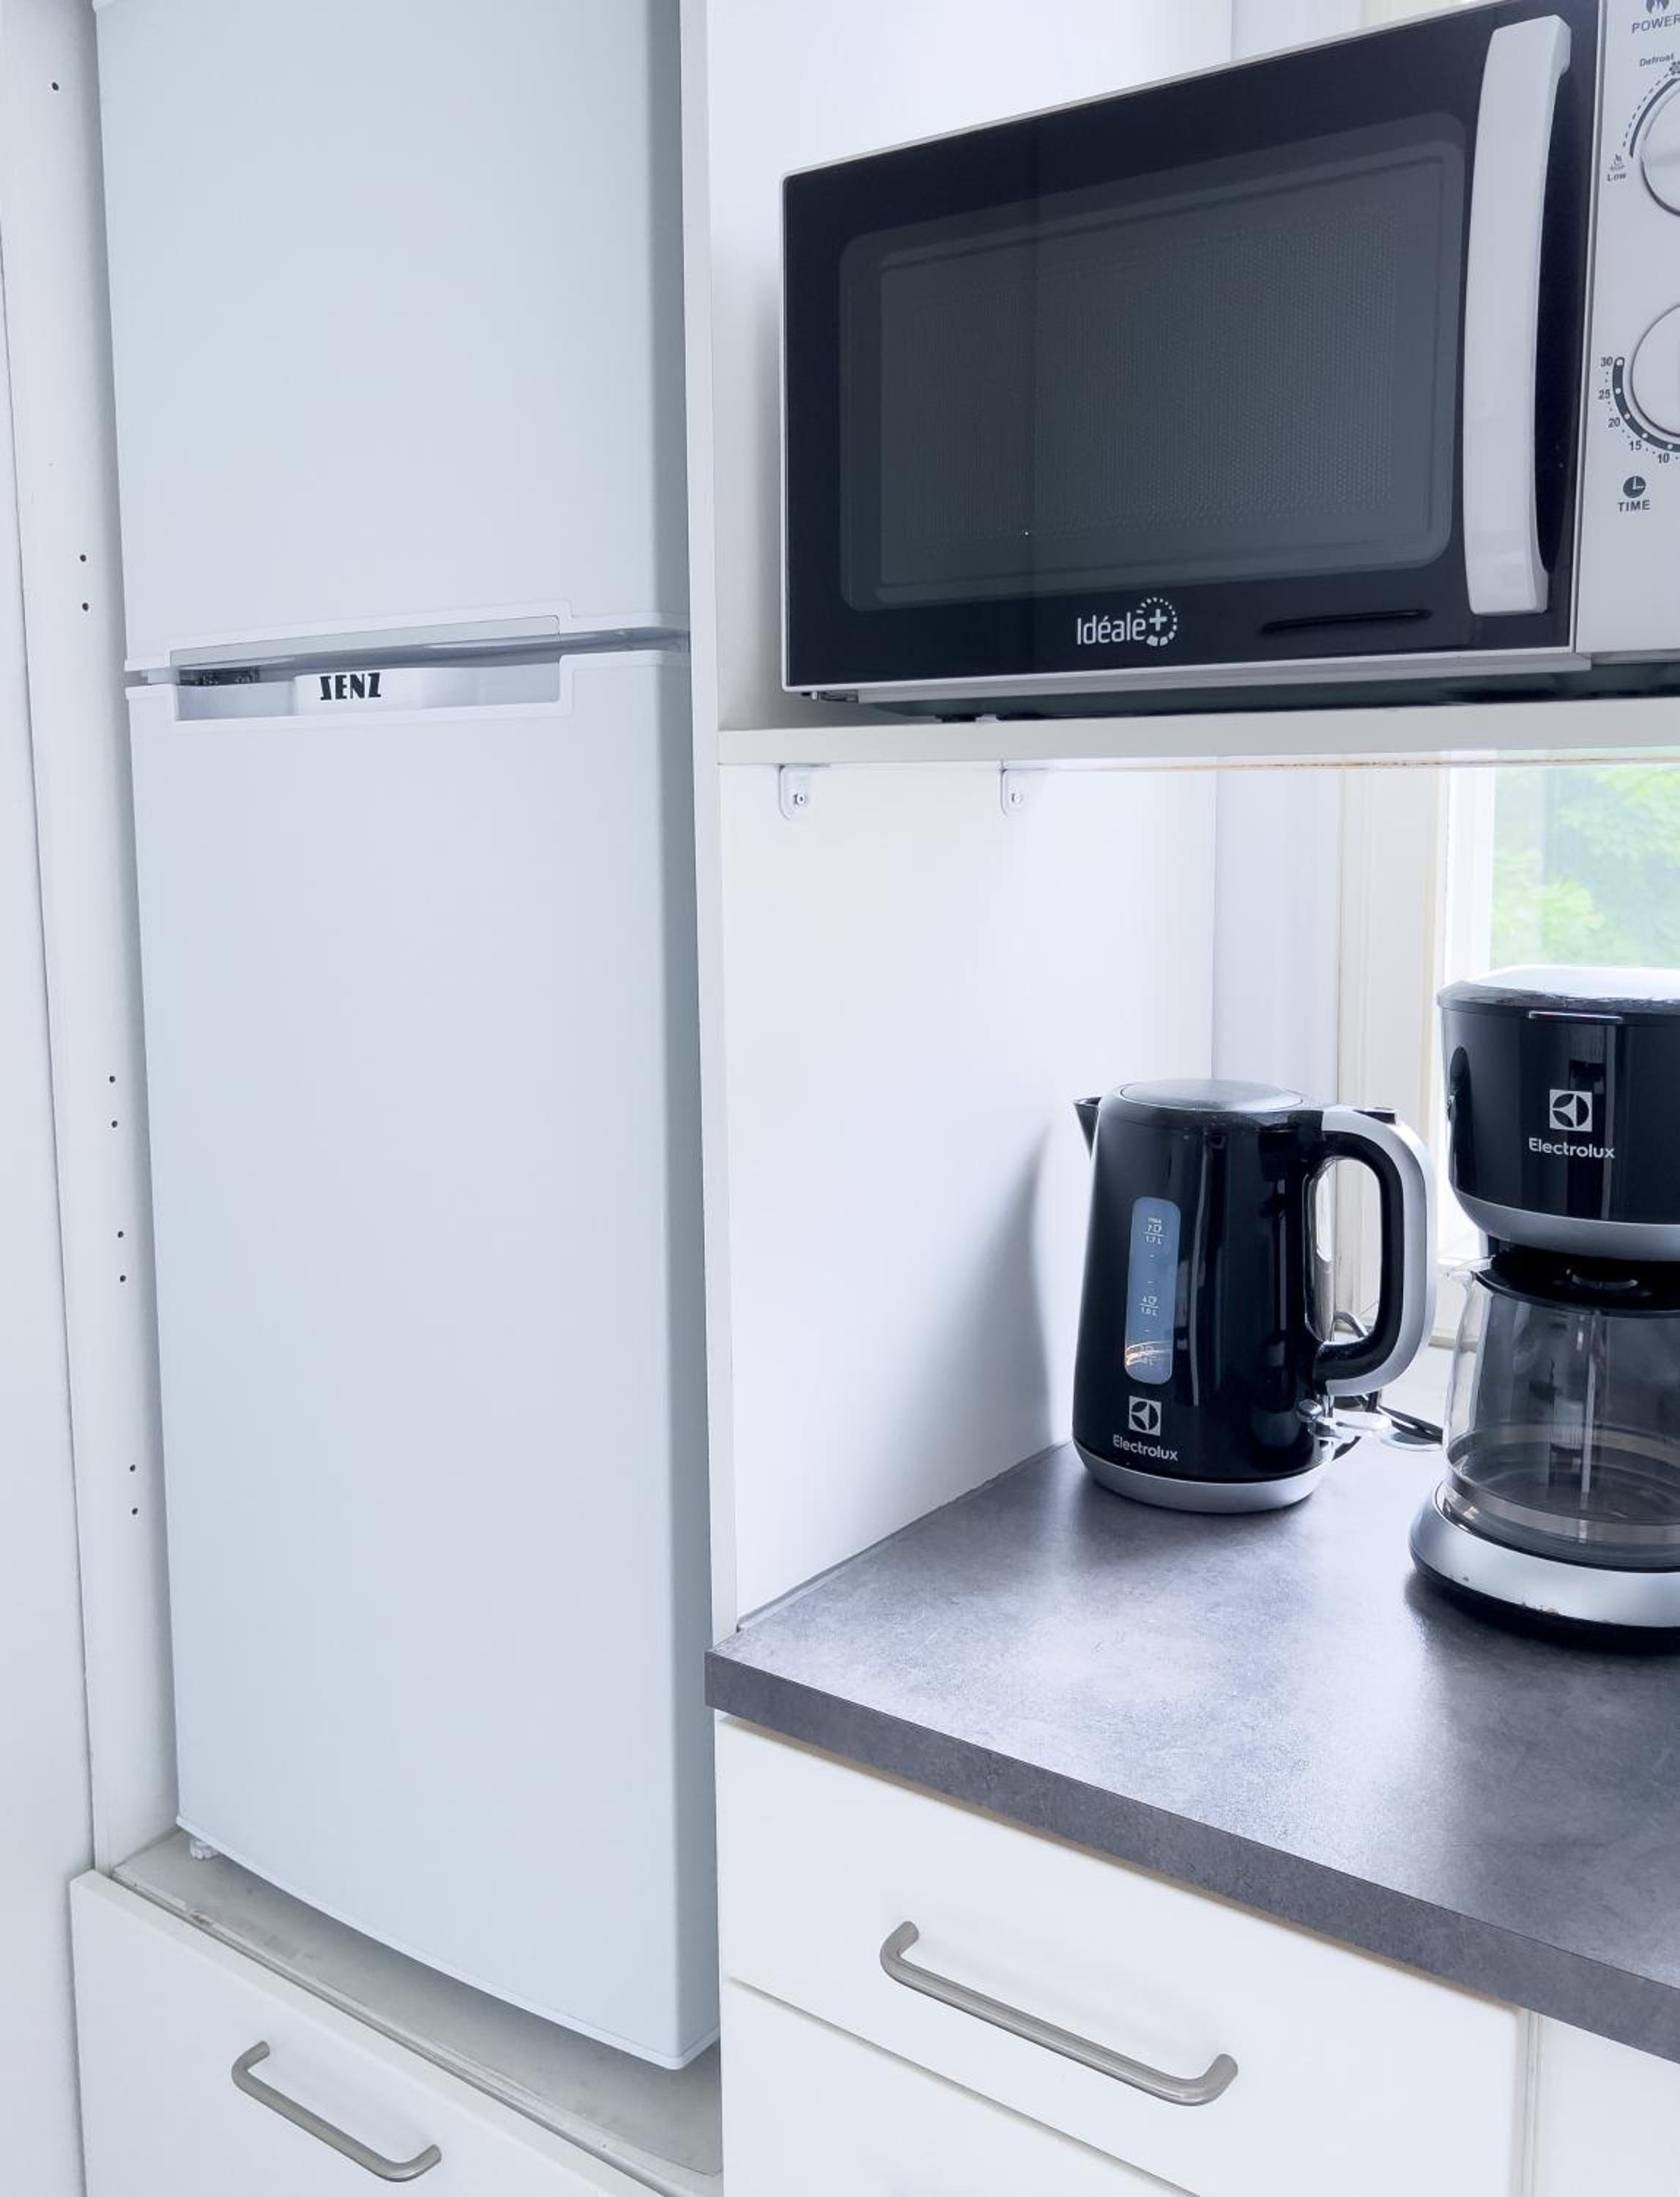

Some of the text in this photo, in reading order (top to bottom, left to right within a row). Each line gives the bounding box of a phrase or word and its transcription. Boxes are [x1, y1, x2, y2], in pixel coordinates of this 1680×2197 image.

[1632, 15, 1680, 34] POWER
[1640, 53, 1674, 67] Defrost
[1607, 173, 1627, 182] Low
[1600, 357, 1613, 367] 30
[1598, 390, 1610, 400] 25
[1608, 417, 1621, 428] 20
[1629, 441, 1642, 451] 15
[1658, 453, 1670, 464] 10
[1617, 499, 1650, 513] TIME
[319, 672, 382, 700] SENZ
[1528, 1137, 1615, 1159] Electrolux
[1112, 1433, 1178, 1462] Electrolux
